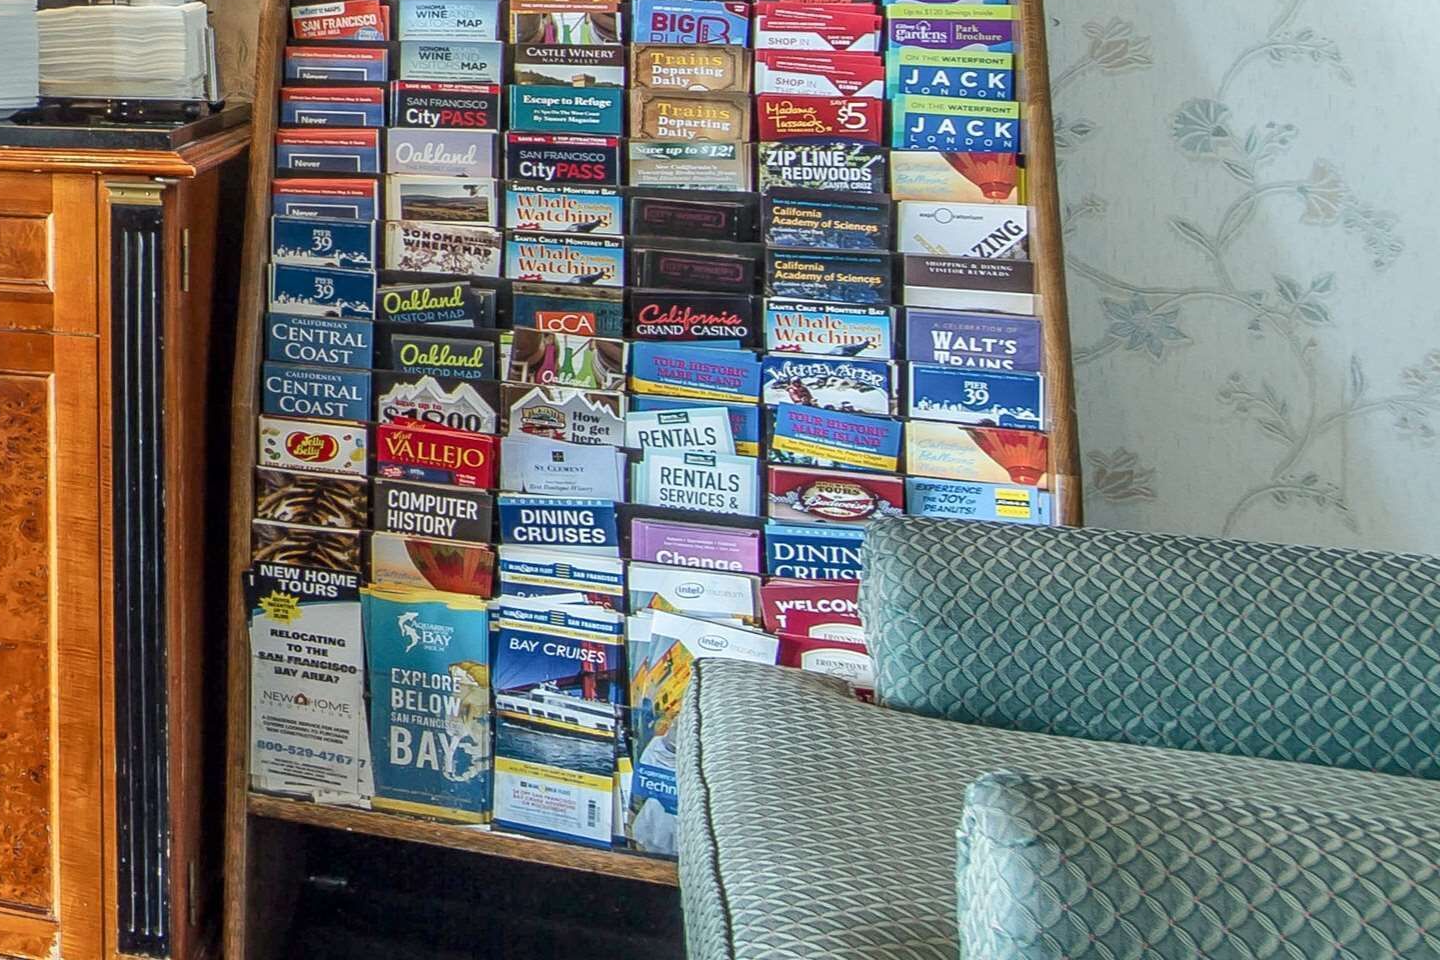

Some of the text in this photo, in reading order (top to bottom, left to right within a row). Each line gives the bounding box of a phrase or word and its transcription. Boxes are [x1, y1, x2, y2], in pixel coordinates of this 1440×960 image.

[416, 10, 448, 18] WINE
[652, 13, 695, 33] BIG
[526, 47, 615, 58] CASTLE WINERY
[651, 53, 723, 66] Trains
[652, 66, 723, 77] Departing
[905, 69, 1006, 88] JACK
[652, 76, 689, 87] Daily
[523, 95, 612, 108] Escape to Refuge
[766, 101, 816, 114] Madame
[406, 109, 487, 127] CityPASS
[658, 103, 730, 119] Trains
[837, 102, 867, 129] $5
[658, 116, 730, 131] Departing
[911, 117, 1012, 138] JACK
[396, 143, 478, 165] Oakland
[636, 146, 663, 154] Save
[700, 145, 734, 157] $12!
[766, 151, 845, 166] ZIP LINE
[520, 161, 606, 180] CityPASS
[782, 167, 872, 181] REDWOODS
[518, 195, 578, 210] Whale
[516, 209, 613, 227] Watching!
[772, 207, 822, 218] California
[772, 216, 819, 228] Academy
[834, 221, 878, 232] Sciences
[311, 236, 332, 251] 39
[403, 238, 492, 258] WINERY MAP
[313, 284, 335, 299] 39
[383, 287, 464, 313] Oakland
[292, 318, 348, 329] CALIFORNIA'S
[389, 310, 465, 323] VISITOR MAP
[640, 304, 742, 331] California
[272, 323, 368, 348] CENTRAL
[637, 324, 747, 336] GRAND CASINO
[931, 330, 1017, 354] WALT'S
[284, 343, 353, 364] COAST
[767, 361, 884, 386] WHITEWATER
[266, 377, 362, 400] CENTRAL
[279, 397, 348, 417] COAST
[572, 412, 600, 423] How
[572, 422, 609, 435] to get
[301, 436, 324, 448] Jelly
[639, 427, 716, 448] RENTALS
[293, 445, 320, 455] Belly
[385, 437, 484, 468] VALLEJO
[660, 467, 739, 492] RENTALS
[817, 486, 860, 495] TOURS
[916, 483, 982, 494] EXPERIENCE
[387, 489, 477, 521] COMPUTER
[660, 488, 738, 509] SERVICES &
[521, 509, 594, 526] DINING
[923, 504, 976, 514] PEANUTS!
[387, 510, 456, 537] HISTORY
[513, 526, 606, 543] CRUISES
[655, 551, 743, 571] Change
[260, 564, 358, 589] NEW HOME
[279, 578, 338, 599] TOURS
[270, 629, 346, 647] RELOCATING
[422, 631, 452, 646] BAY
[702, 638, 724, 648] intel
[286, 643, 329, 657] TO THE
[509, 638, 606, 664] BAY CRUISES
[274, 667, 340, 684] BAY AREA?
[392, 668, 461, 693] EXPLORE
[392, 688, 461, 716] BELOW
[389, 725, 460, 771] BAY
